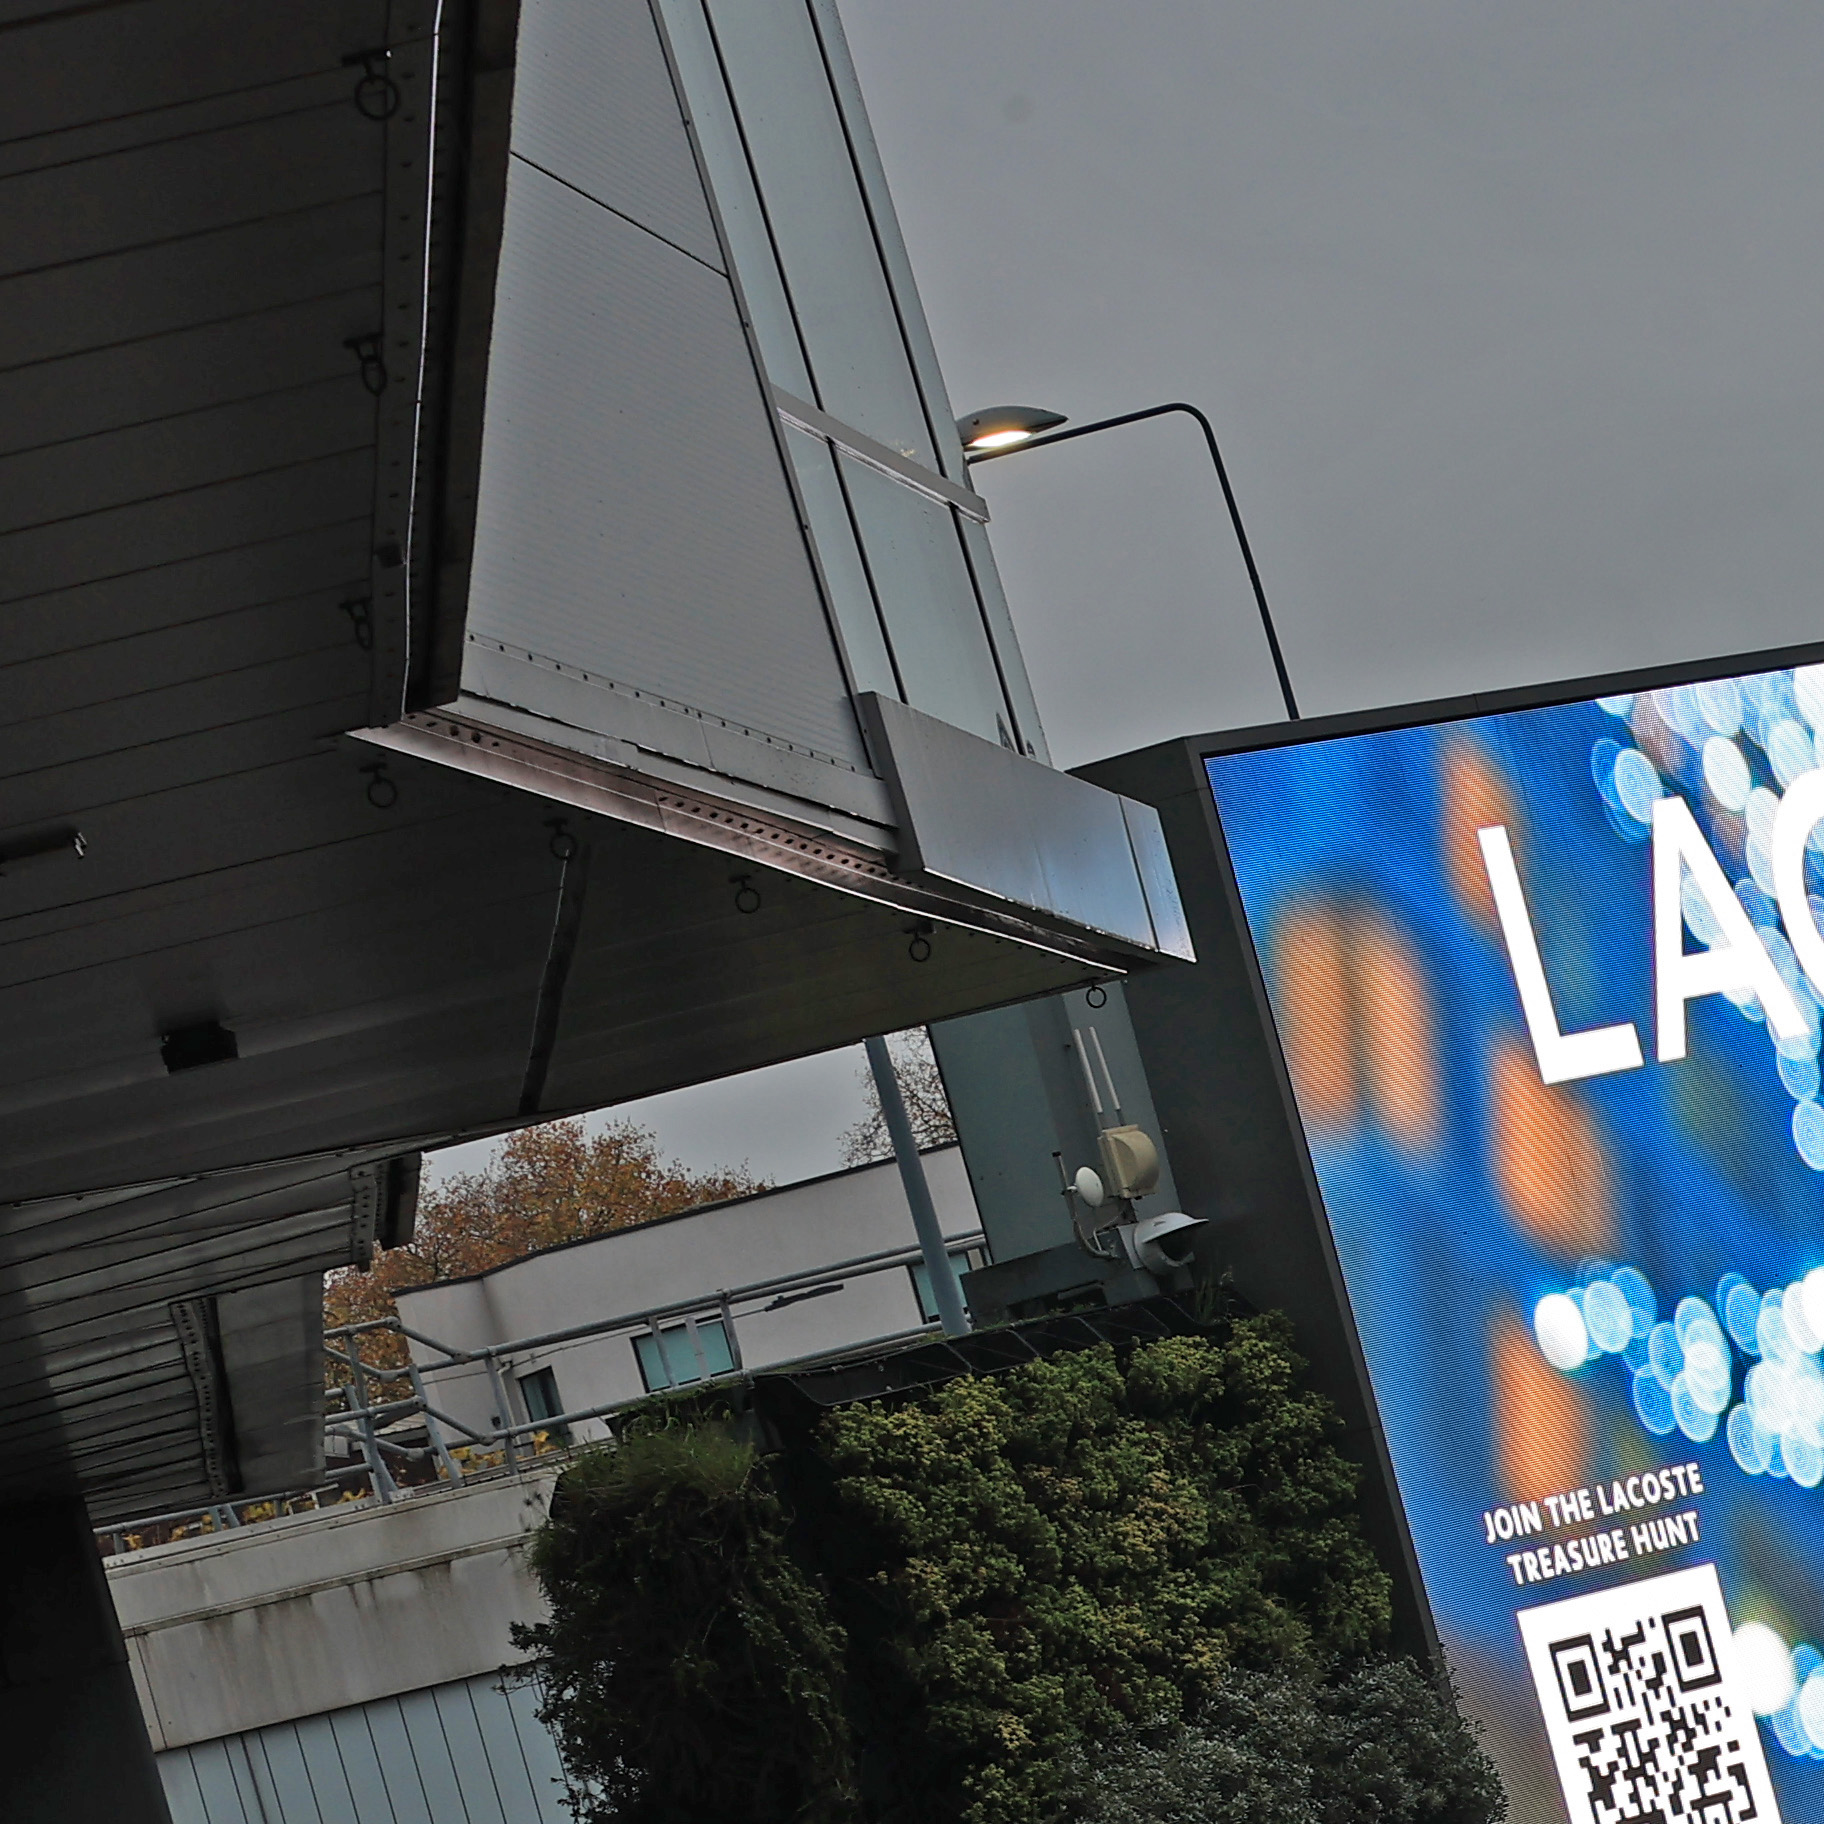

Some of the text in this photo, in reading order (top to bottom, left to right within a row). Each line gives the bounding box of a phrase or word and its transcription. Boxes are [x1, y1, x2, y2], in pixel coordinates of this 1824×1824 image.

[1483, 1463, 1704, 1544] JOIN THE LACOSTE
[1507, 1511, 1699, 1585] TREASURE HUNT
